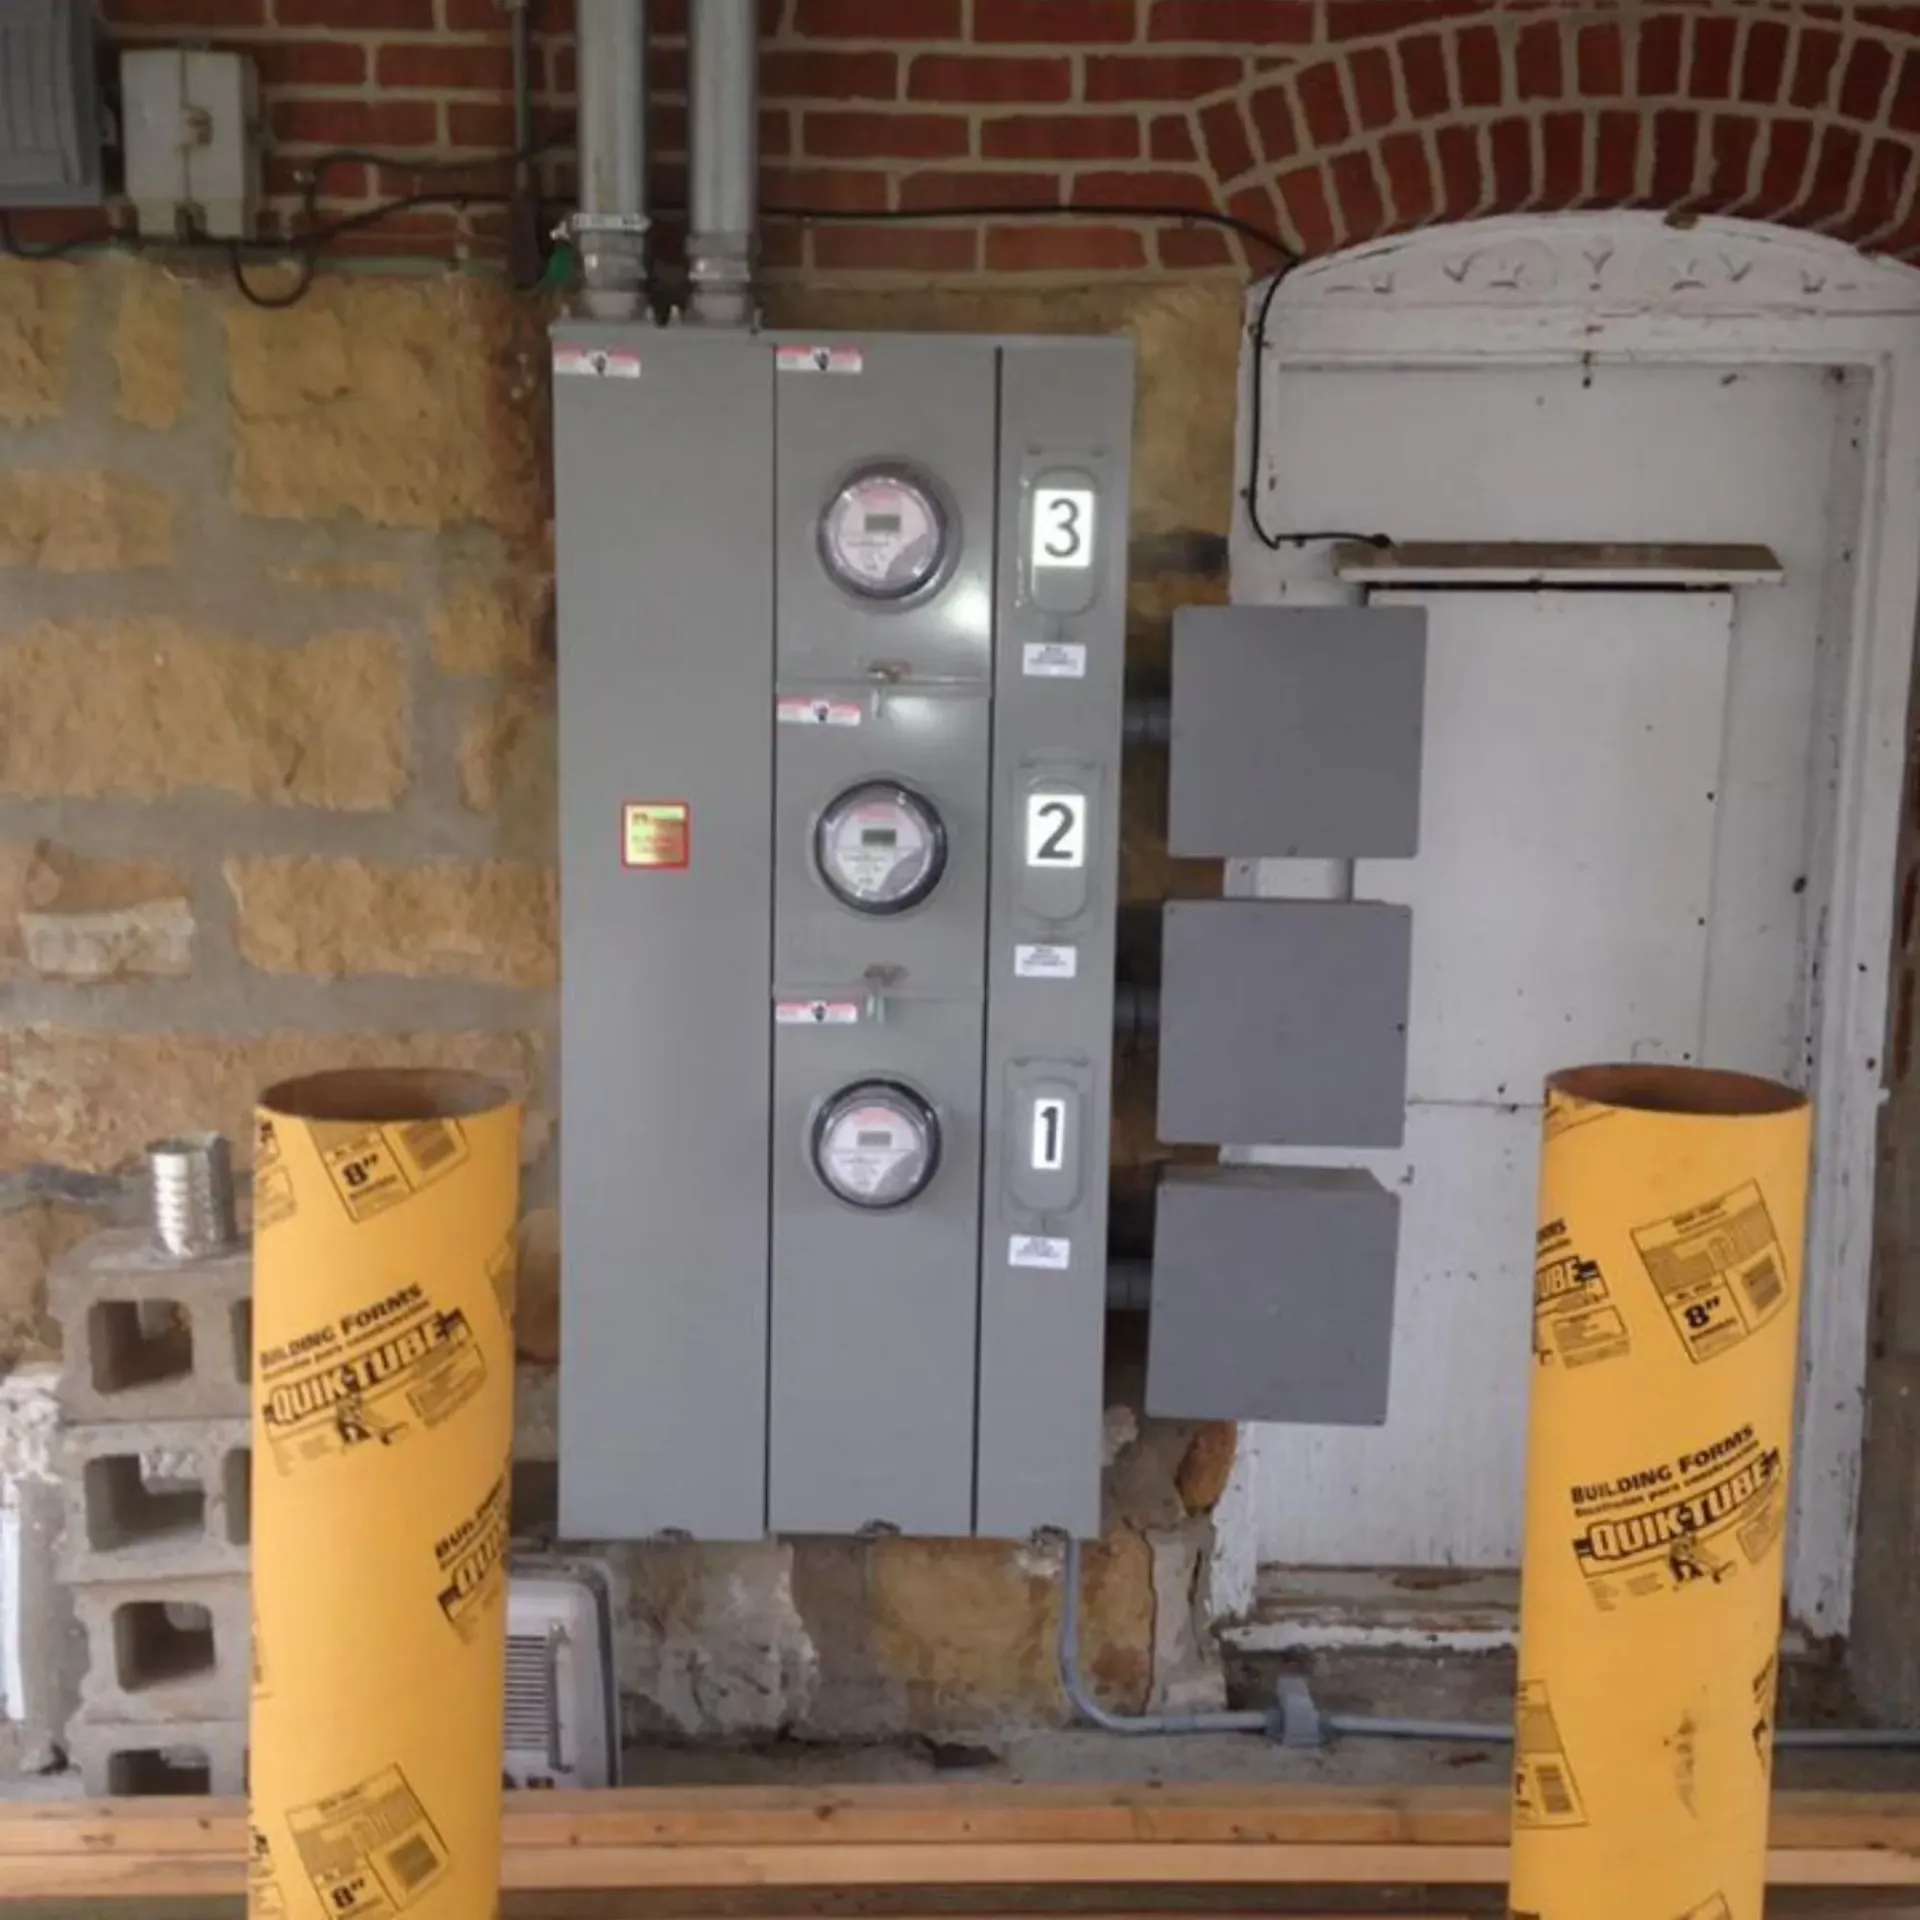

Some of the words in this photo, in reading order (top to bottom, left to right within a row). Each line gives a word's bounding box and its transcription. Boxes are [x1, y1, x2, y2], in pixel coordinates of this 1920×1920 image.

[1044, 498, 1081, 559] 3
[1037, 802, 1075, 859] 2
[1041, 1106, 1059, 1162] 1
[340, 1280, 424, 1337] FORMS
[1571, 1464, 1673, 1505] BUILDING
[1677, 1422, 1754, 1475] FORMS
